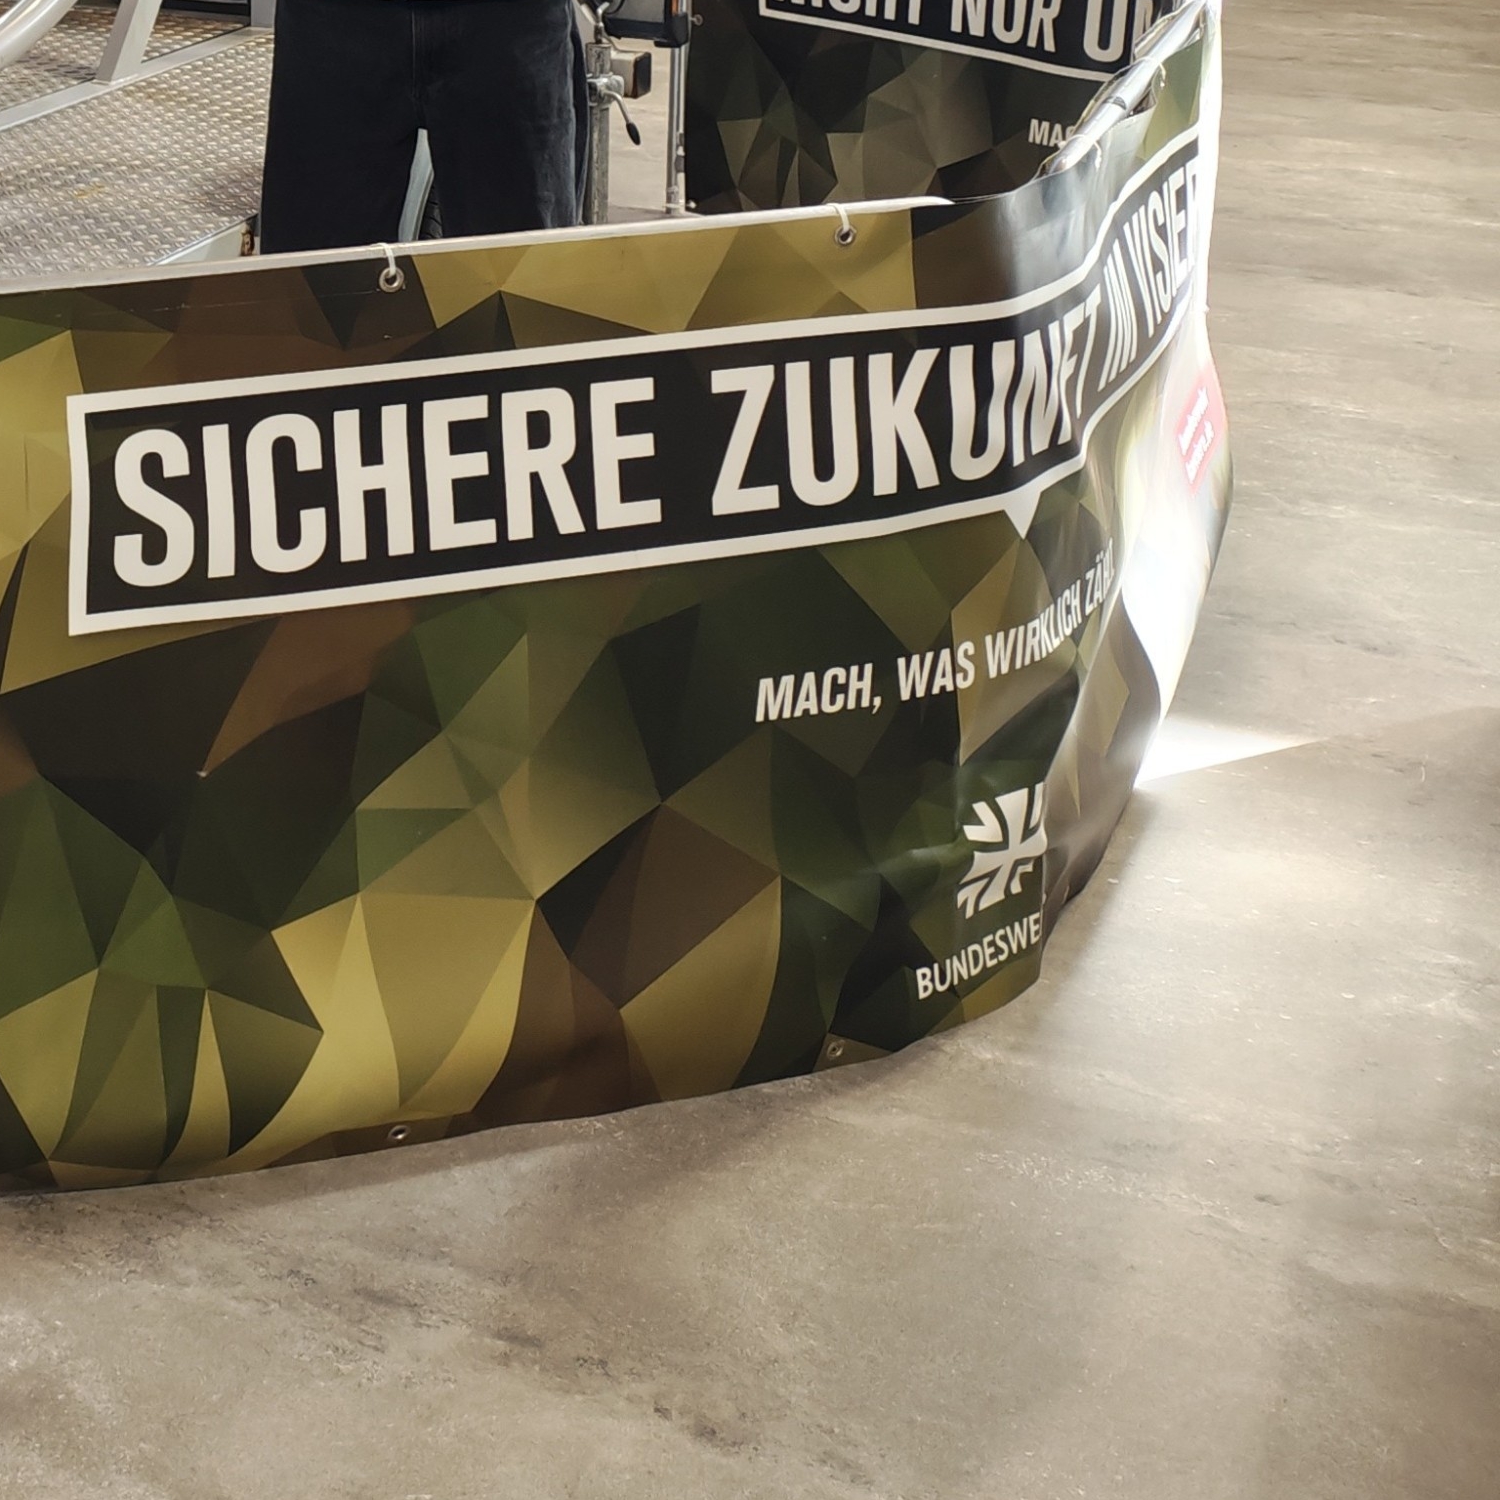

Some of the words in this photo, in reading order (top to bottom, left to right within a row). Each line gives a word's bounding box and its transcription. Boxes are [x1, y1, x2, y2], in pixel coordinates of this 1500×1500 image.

[113, 376, 663, 588] SICHERE
[711, 283, 1101, 517] ZUKUNFT
[1098, 237, 1138, 393] IM
[755, 663, 882, 723] MACH,
[897, 640, 975, 702] WAS
[984, 579, 1083, 679] WIRKLICH
